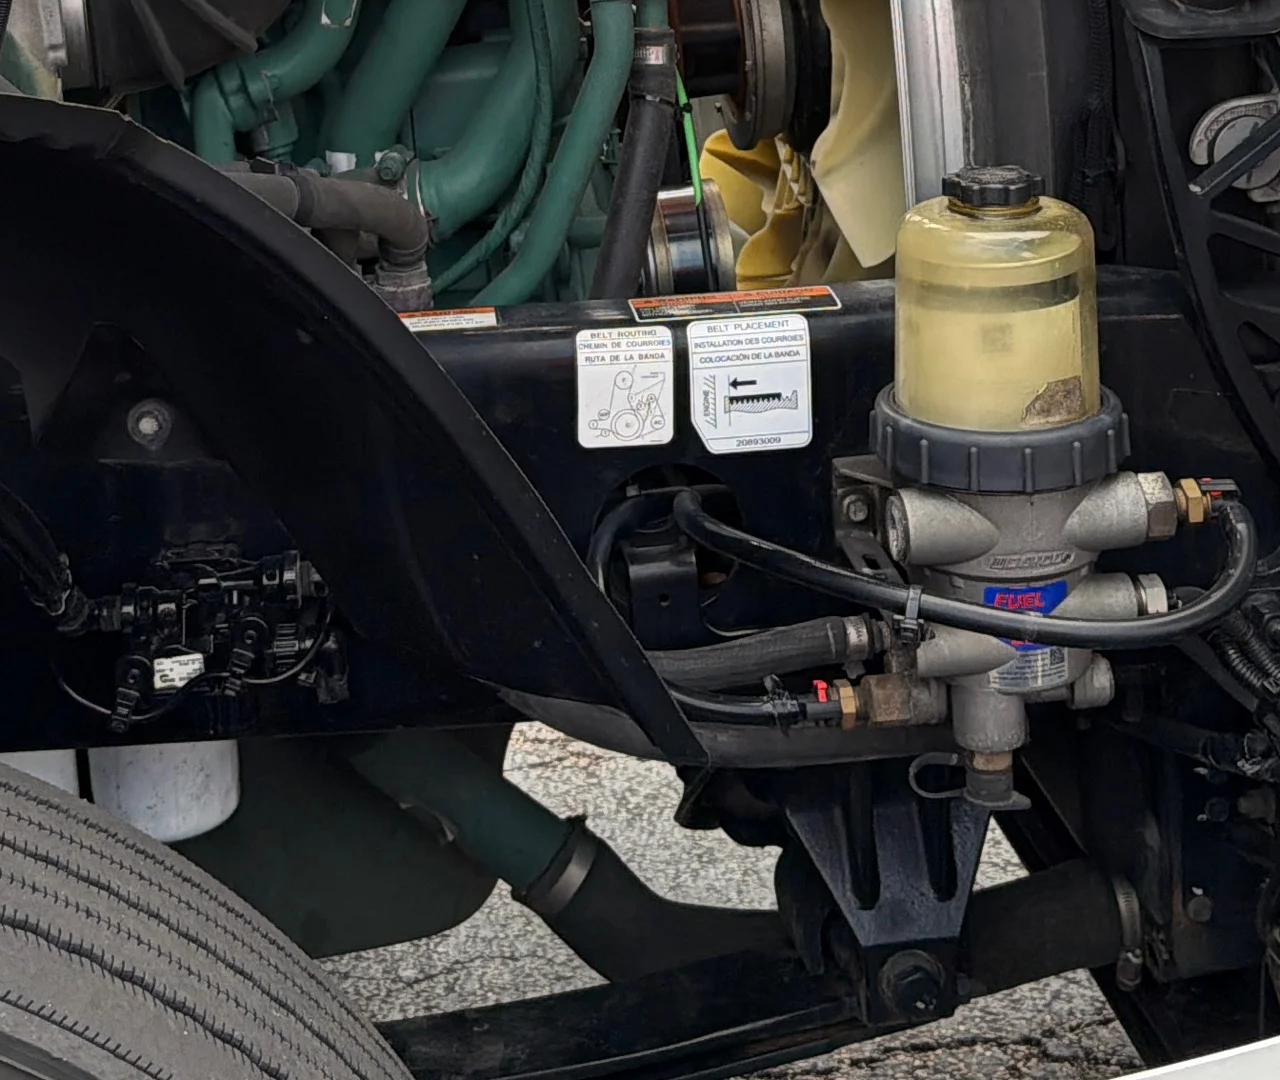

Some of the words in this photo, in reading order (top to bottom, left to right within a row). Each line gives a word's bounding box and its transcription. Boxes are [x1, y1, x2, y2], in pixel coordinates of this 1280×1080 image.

[707, 324, 729, 333] BELT
[734, 319, 790, 331] PLACEMENT
[617, 329, 657, 338] ROUTING
[578, 342, 608, 350] CHEMIN
[626, 339, 671, 348] COURROIES
[694, 338, 743, 349] INSTALLATION
[745, 336, 760, 345] DES
[761, 334, 804, 344] COURROIES
[585, 355, 607, 363] RUTA
[610, 354, 621, 362] DE
[624, 353, 634, 361] LA
[638, 352, 665, 360] BANDA
[700, 352, 750, 364] COLOCACIÓN
[751, 351, 762, 360] DE
[763, 350, 773, 359] LA
[774, 349, 800, 358] BANDA
[703, 389, 711, 417] ENGINE
[736, 436, 782, 447] 20893009
[994, 592, 1044, 610] FUEL
